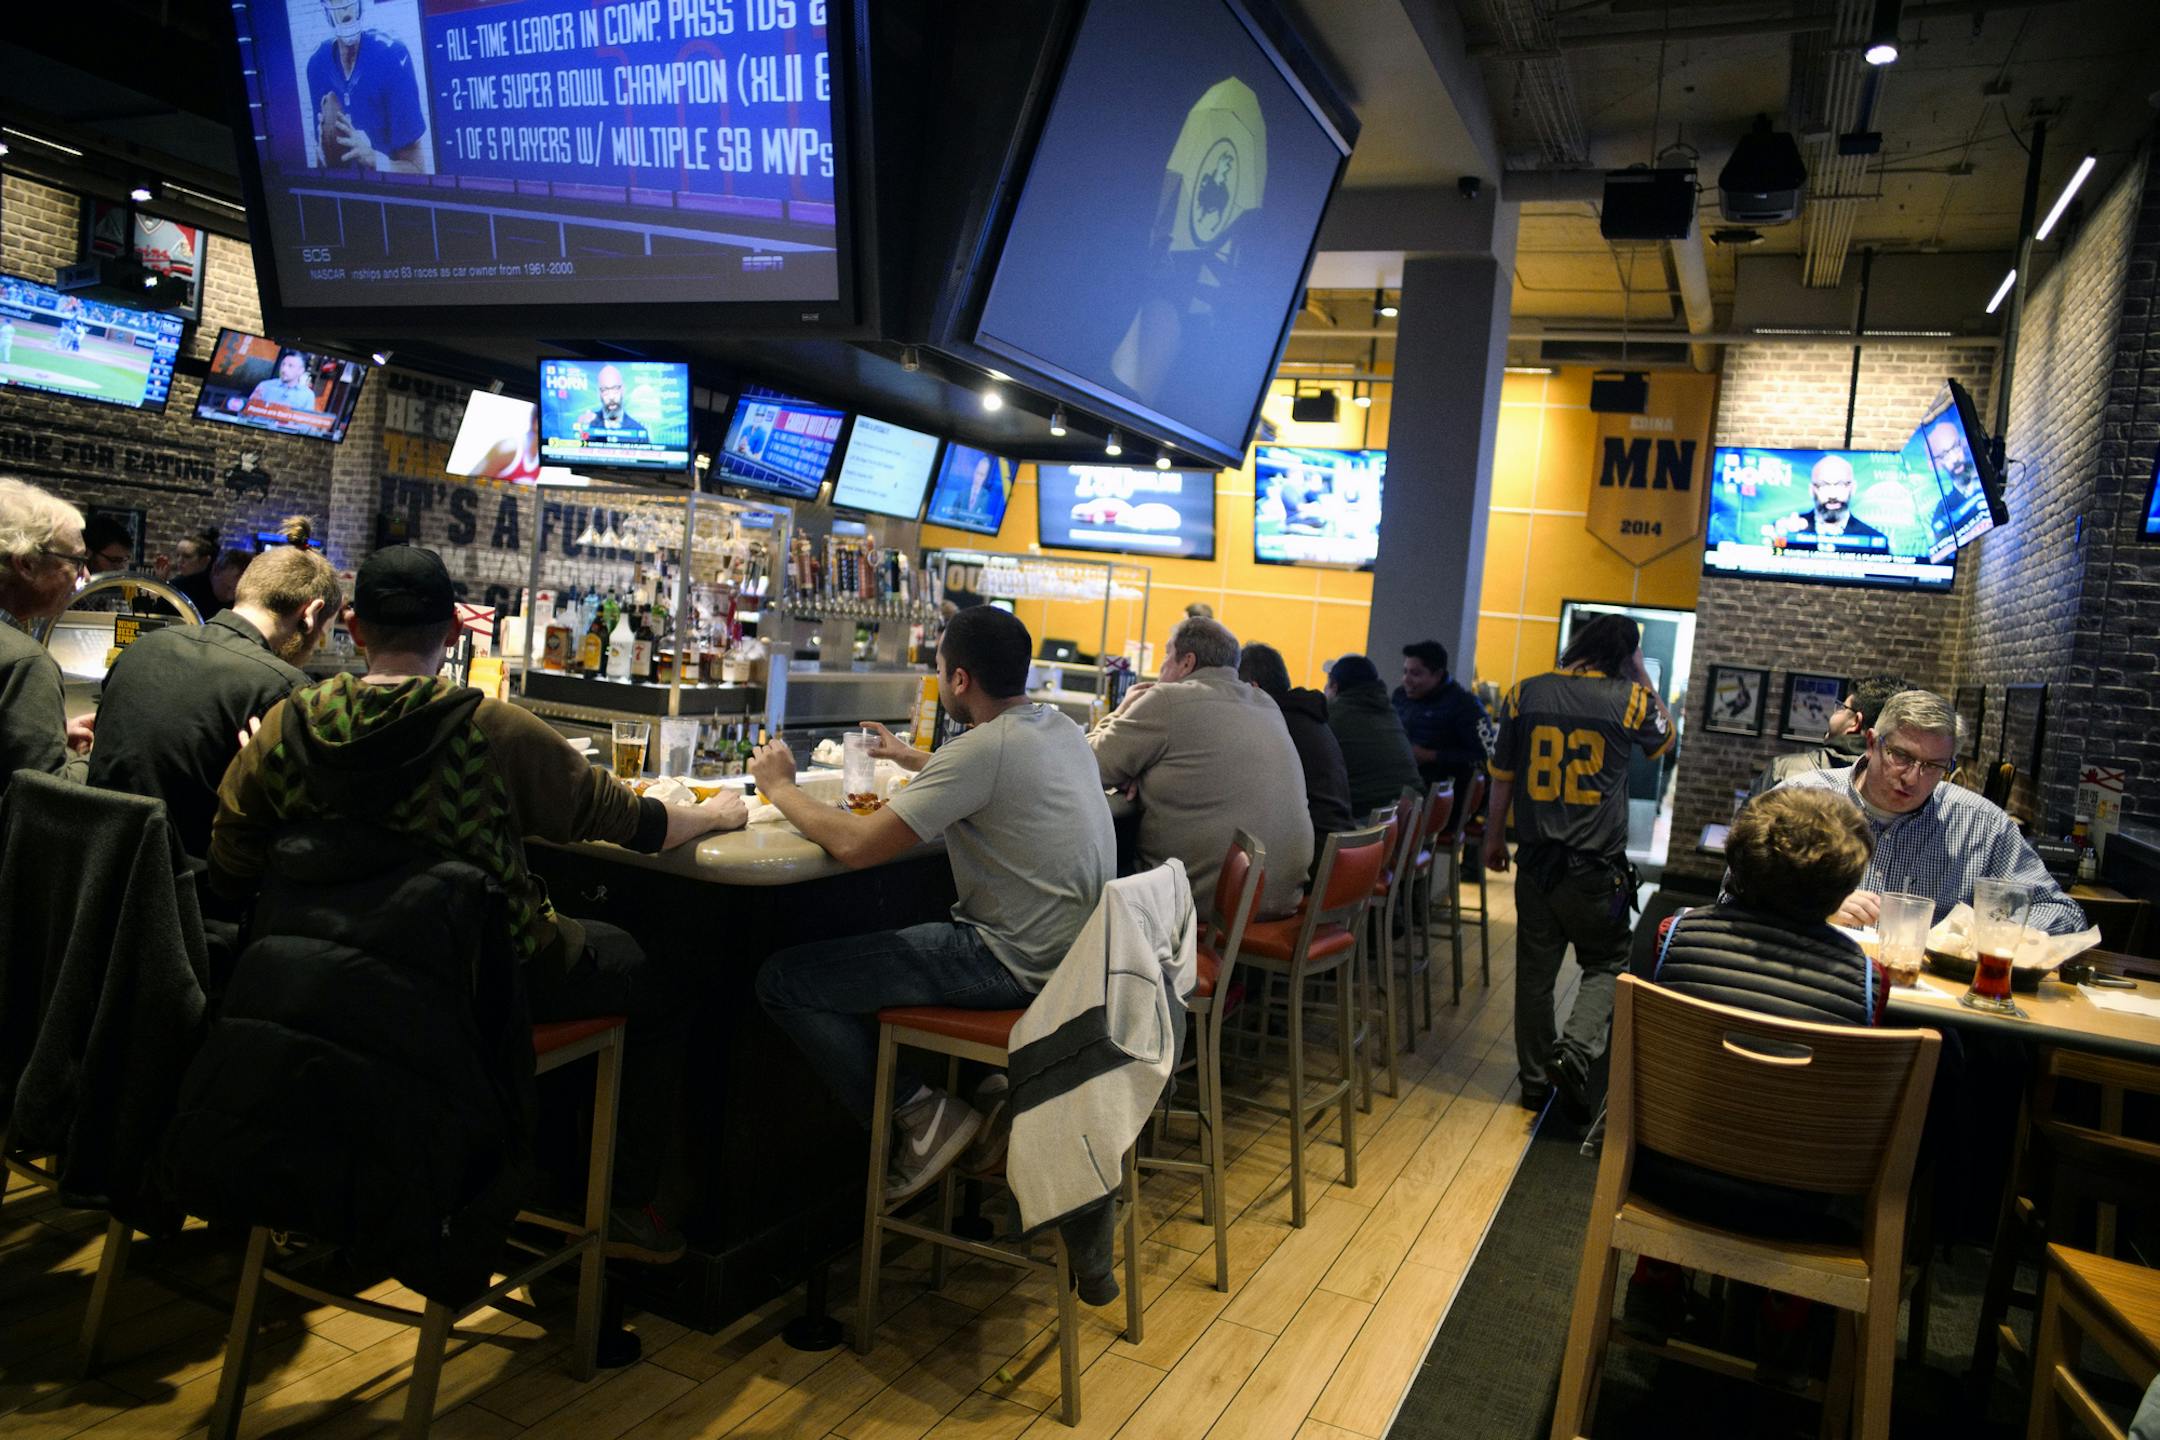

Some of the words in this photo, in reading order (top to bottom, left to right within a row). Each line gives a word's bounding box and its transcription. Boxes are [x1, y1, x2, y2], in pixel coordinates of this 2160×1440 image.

[512, 12, 575, 55] LEADER
[579, 8, 600, 49] IN
[667, 0, 735, 39] PASS
[501, 72, 554, 109] SUPER
[557, 67, 609, 108] BOWL
[613, 59, 729, 106] CHAMPION
[456, 127, 463, 159] 1
[466, 126, 482, 160] OF
[500, 126, 572, 164] PLAYERS
[575, 121, 604, 167] W/
[611, 126, 711, 171] MULTIPLE
[717, 126, 753, 173] SB
[309, 269, 346, 281] NASCAR
[383, 267, 400, 280] and
[413, 268, 439, 279] races
[439, 268, 451, 278] as
[452, 267, 468, 278] car
[468, 266, 498, 278] owner
[499, 265, 522, 277] from
[546, 375, 588, 391] HORN
[1599, 436, 1697, 492] MN
[1723, 465, 1792, 488] HORN
[490, 493, 521, 549] A
[1620, 519, 1662, 537] 2014
[1527, 725, 1606, 806] 82
